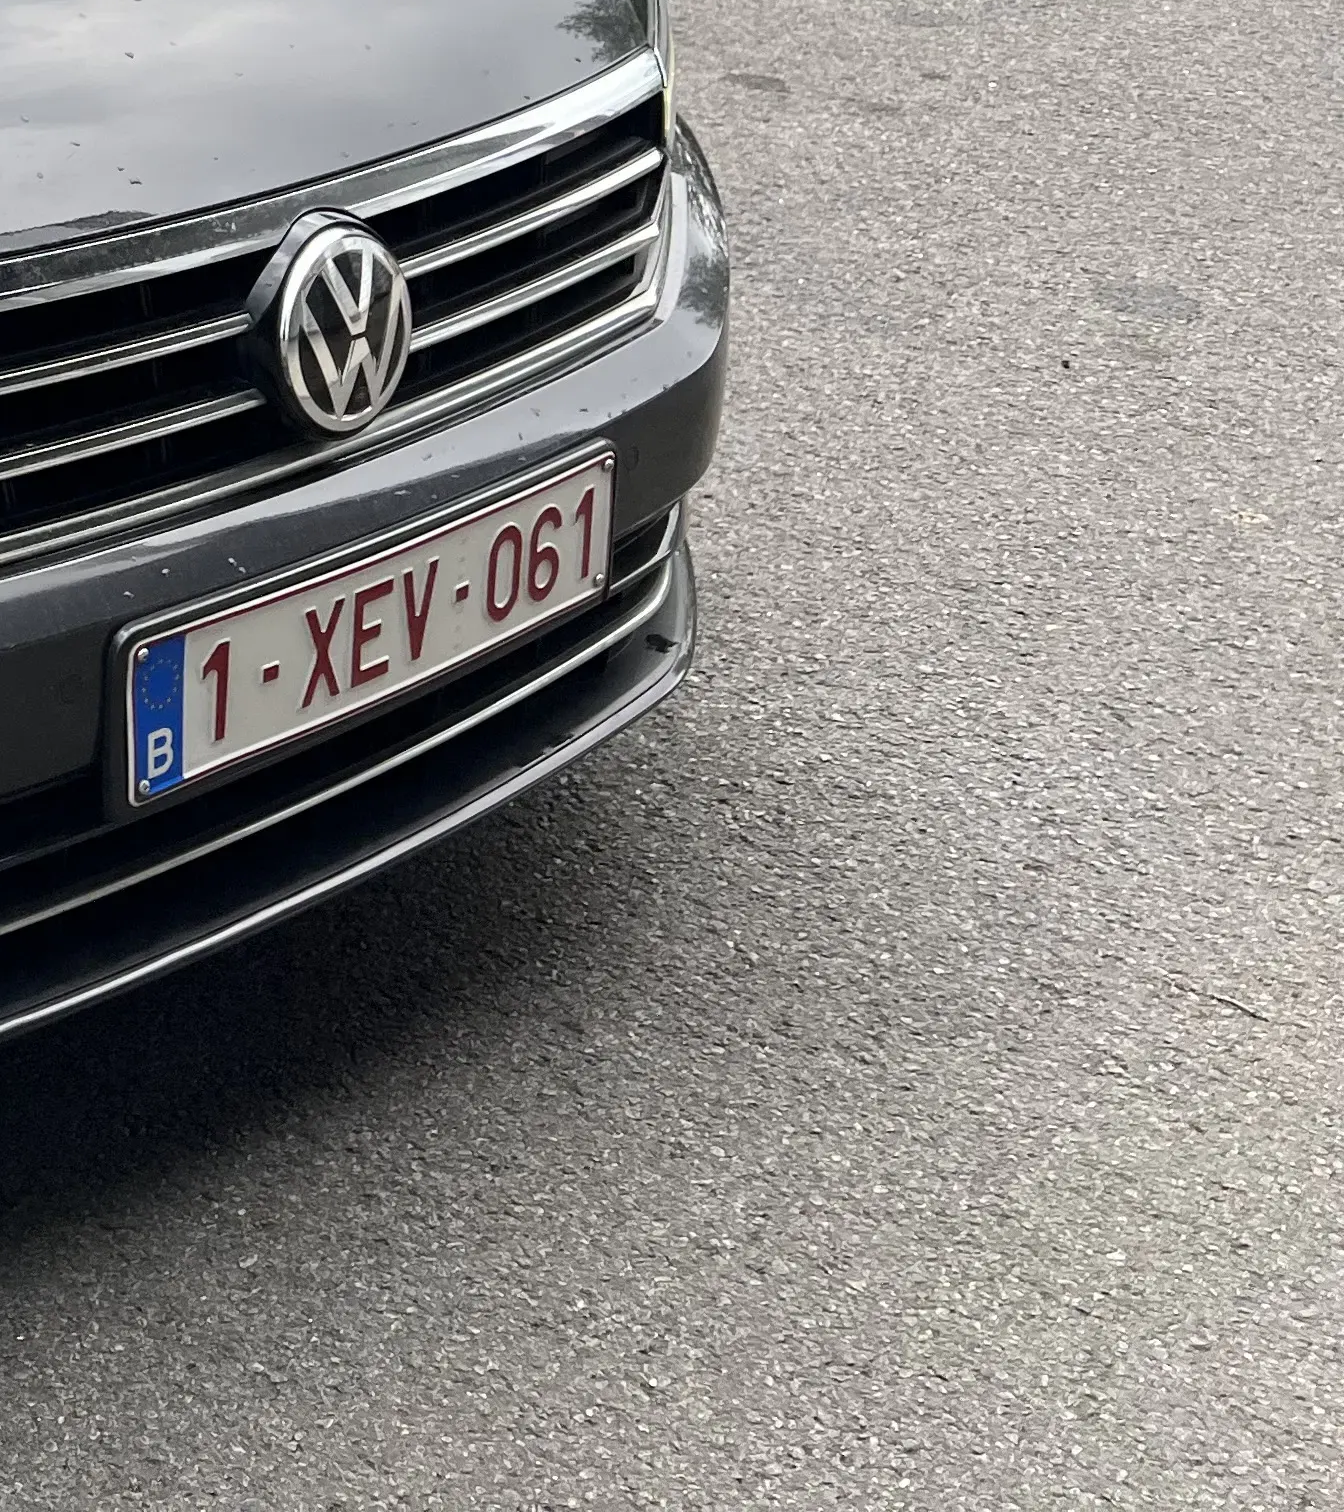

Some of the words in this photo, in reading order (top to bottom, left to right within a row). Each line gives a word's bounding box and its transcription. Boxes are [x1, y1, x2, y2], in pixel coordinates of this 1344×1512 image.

[294, 236, 407, 425] VW
[201, 486, 596, 742] 1-XEV-061
[147, 727, 174, 780] B
